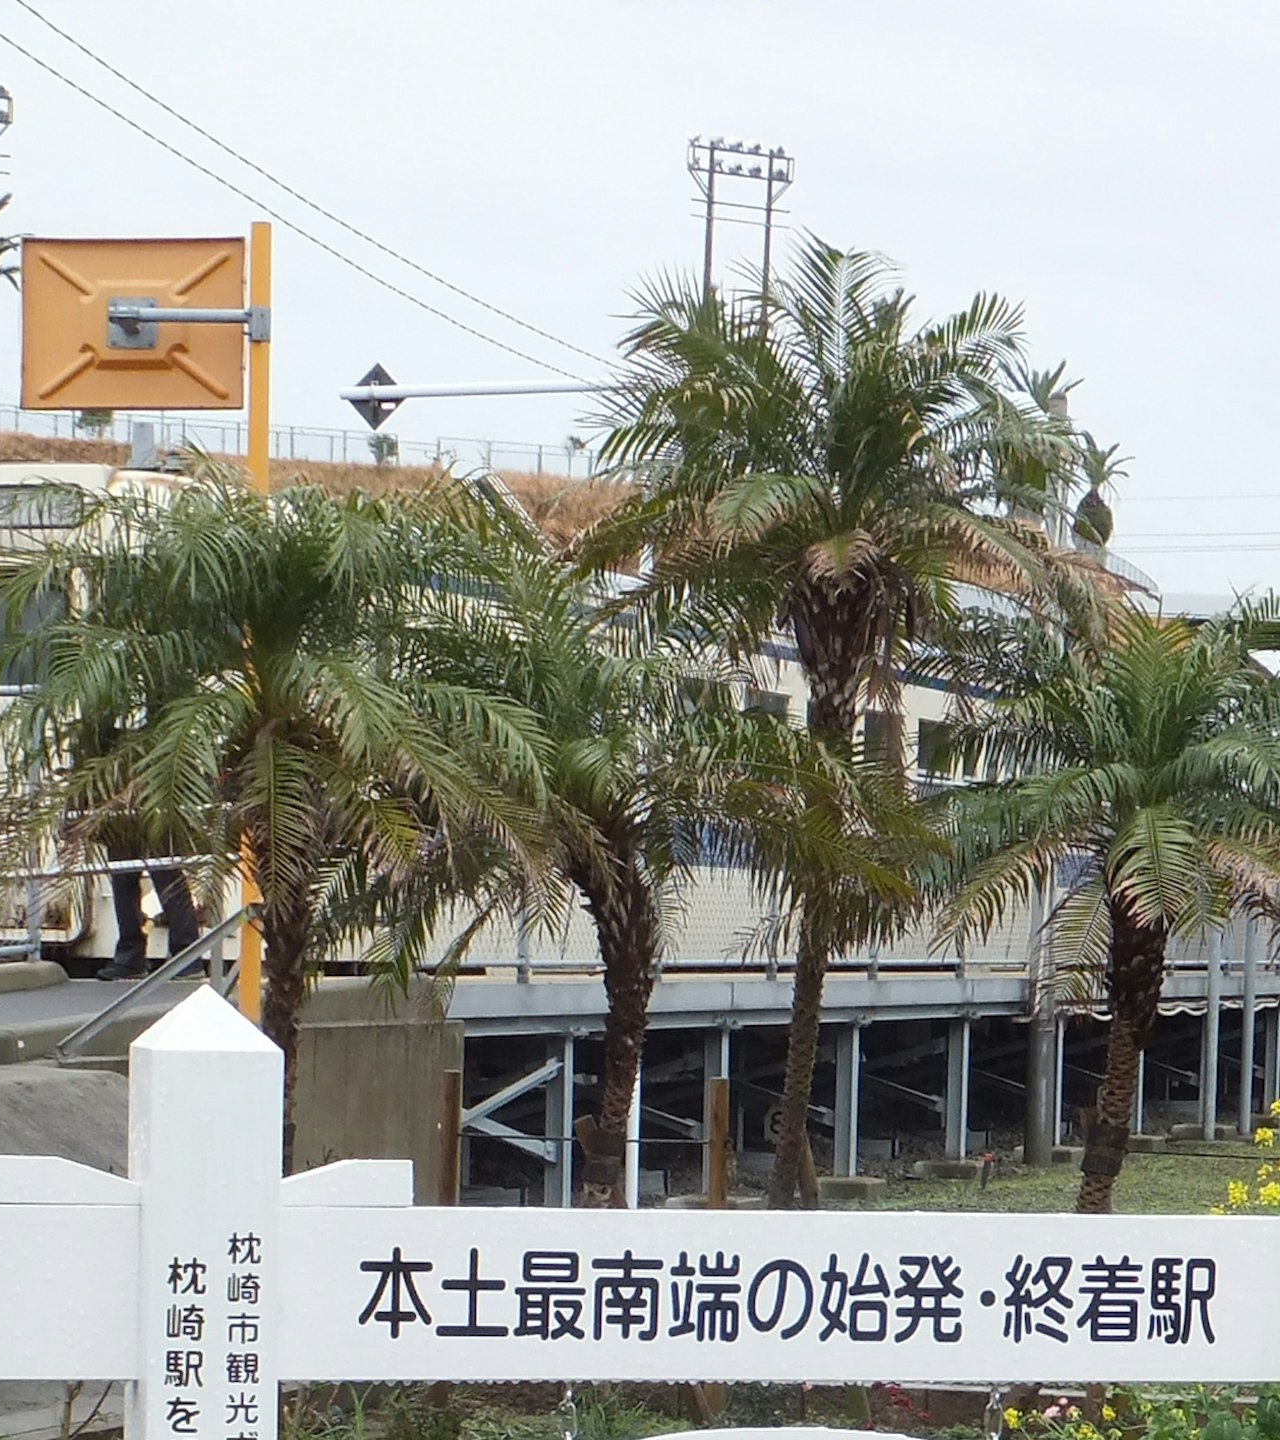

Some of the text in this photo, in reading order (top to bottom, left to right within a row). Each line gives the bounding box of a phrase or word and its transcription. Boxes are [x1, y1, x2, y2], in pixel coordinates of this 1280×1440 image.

[358, 1246, 1216, 1345] 本土最南端の始発・終着駅
